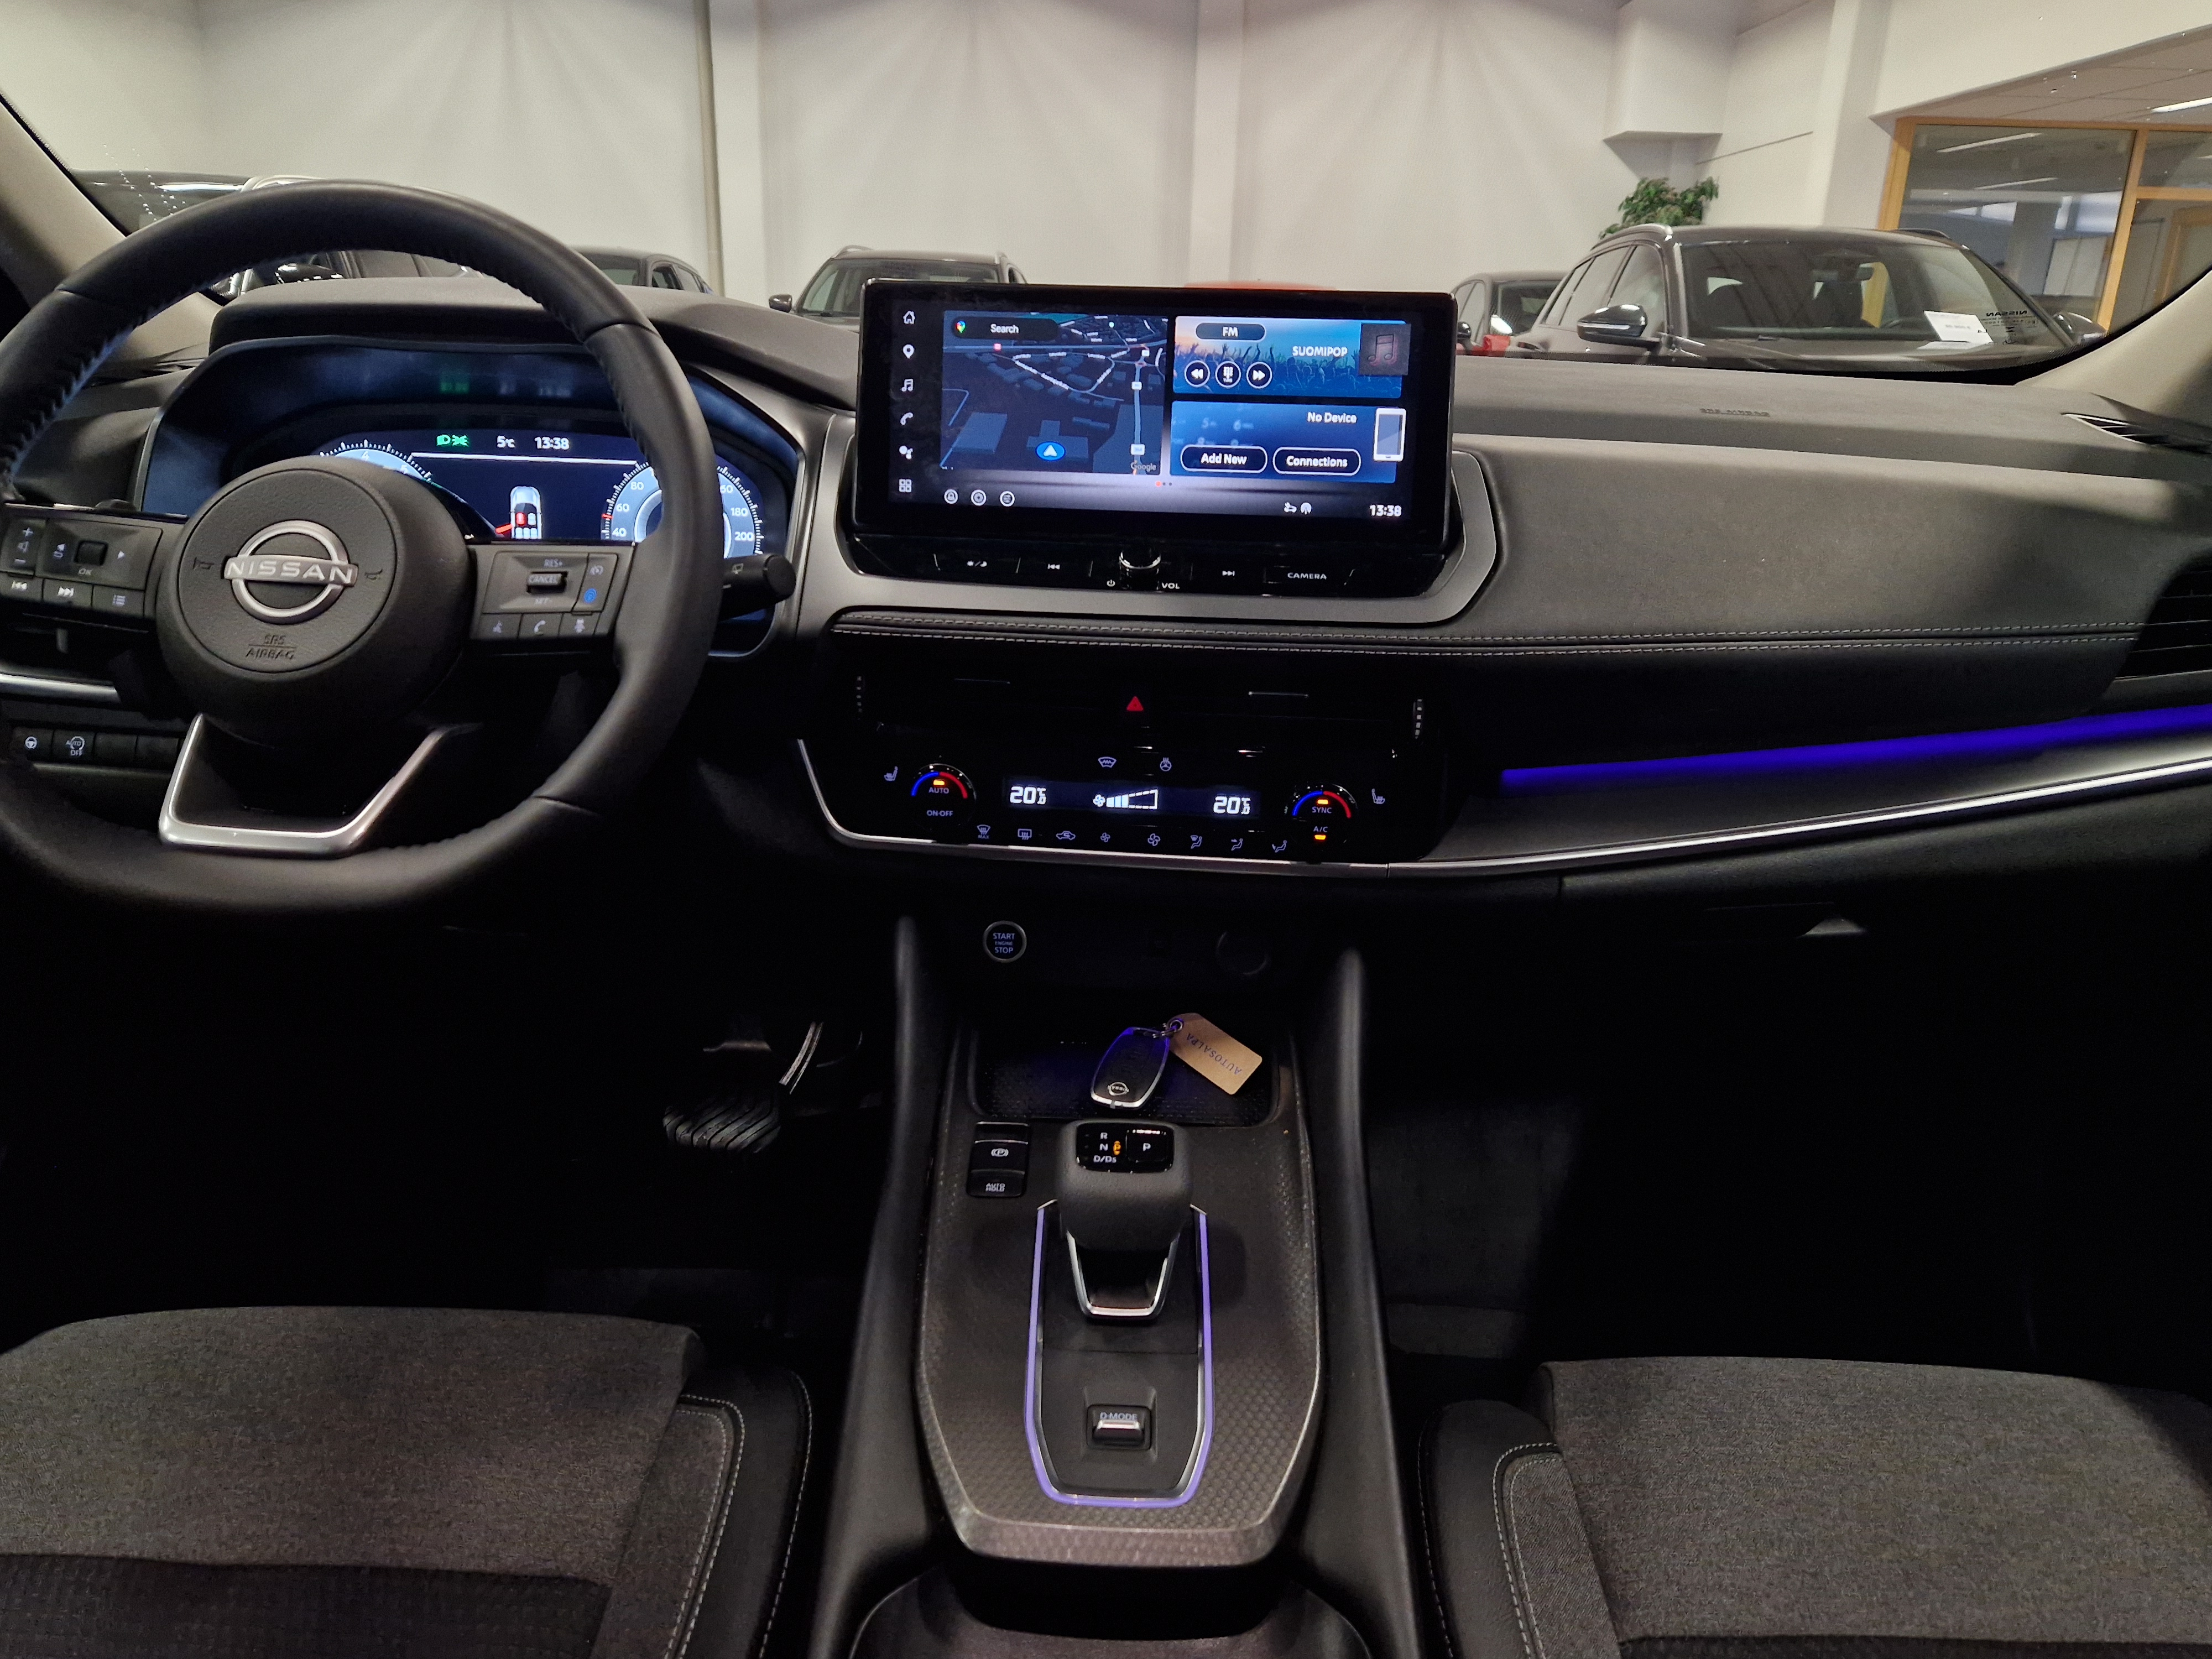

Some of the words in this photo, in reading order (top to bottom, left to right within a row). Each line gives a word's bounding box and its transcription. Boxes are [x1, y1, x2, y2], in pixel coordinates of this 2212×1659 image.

[990, 323, 1019, 334] Search
[1222, 326, 1238, 337] FM
[1292, 346, 1348, 357] SUOMIPOP
[1307, 411, 1322, 422] No
[1324, 413, 1357, 424] Device
[535, 436, 570, 450] 13:38
[1201, 453, 1222, 463] Add
[1224, 453, 1248, 465] New
[1286, 455, 1348, 467] Connections
[1130, 462, 1157, 472] Google
[630, 482, 644, 490] 80
[720, 484, 733, 493] 60
[616, 503, 630, 512] 60
[731, 507, 748, 517] 180
[1369, 504, 1402, 518] 13:38
[612, 528, 627, 537] 40
[734, 531, 754, 541] 200
[227, 561, 353, 585] NISSAN
[1287, 572, 1327, 580] CAMERA
[263, 633, 286, 645] SRS
[245, 647, 295, 660] AIRBAG
[1187, 1033, 1242, 1075] AUTOSALPA
[1099, 1143, 1108, 1151] N
[1142, 1142, 1151, 1151] P
[1093, 1155, 1117, 1163] D/Ds
